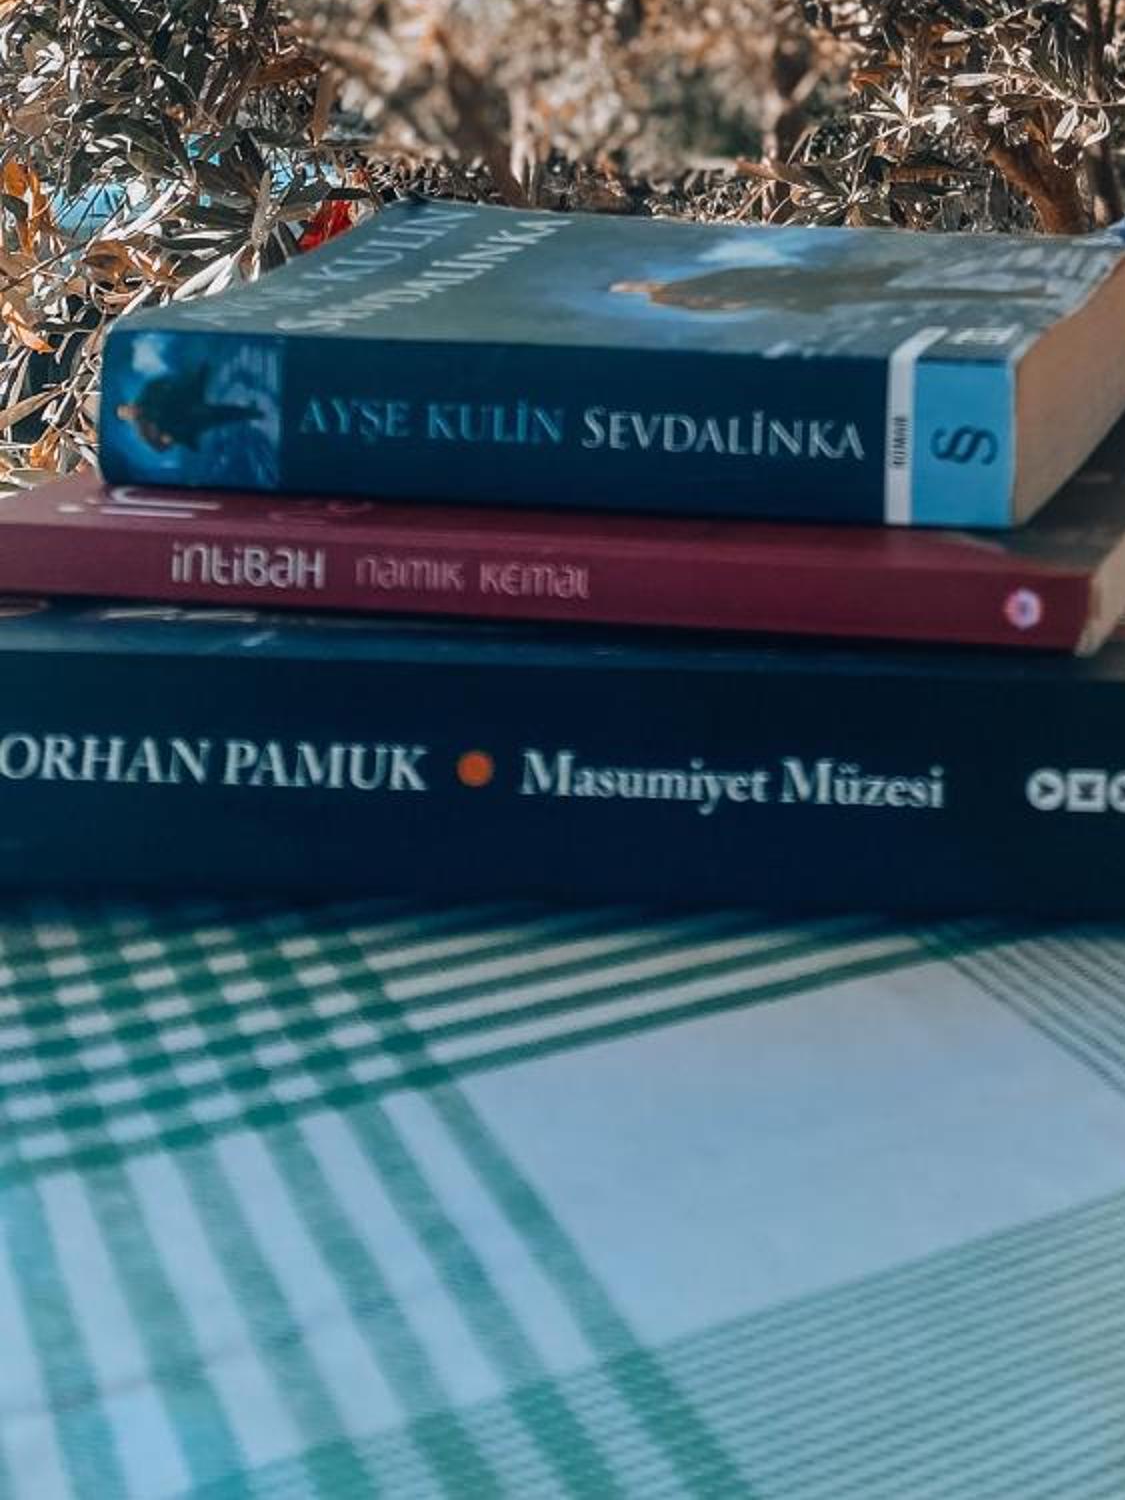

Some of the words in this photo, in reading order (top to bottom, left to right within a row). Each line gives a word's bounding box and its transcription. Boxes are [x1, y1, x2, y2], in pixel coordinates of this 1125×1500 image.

[299, 396, 411, 443] AYŞE
[425, 396, 565, 444] KULİN
[580, 404, 866, 460] SEVDALİNKA
[0, 731, 213, 784] ORHAN
[222, 738, 430, 791] PAMUK
[518, 748, 769, 816] Masumiyet
[779, 756, 946, 809] Müzesi
